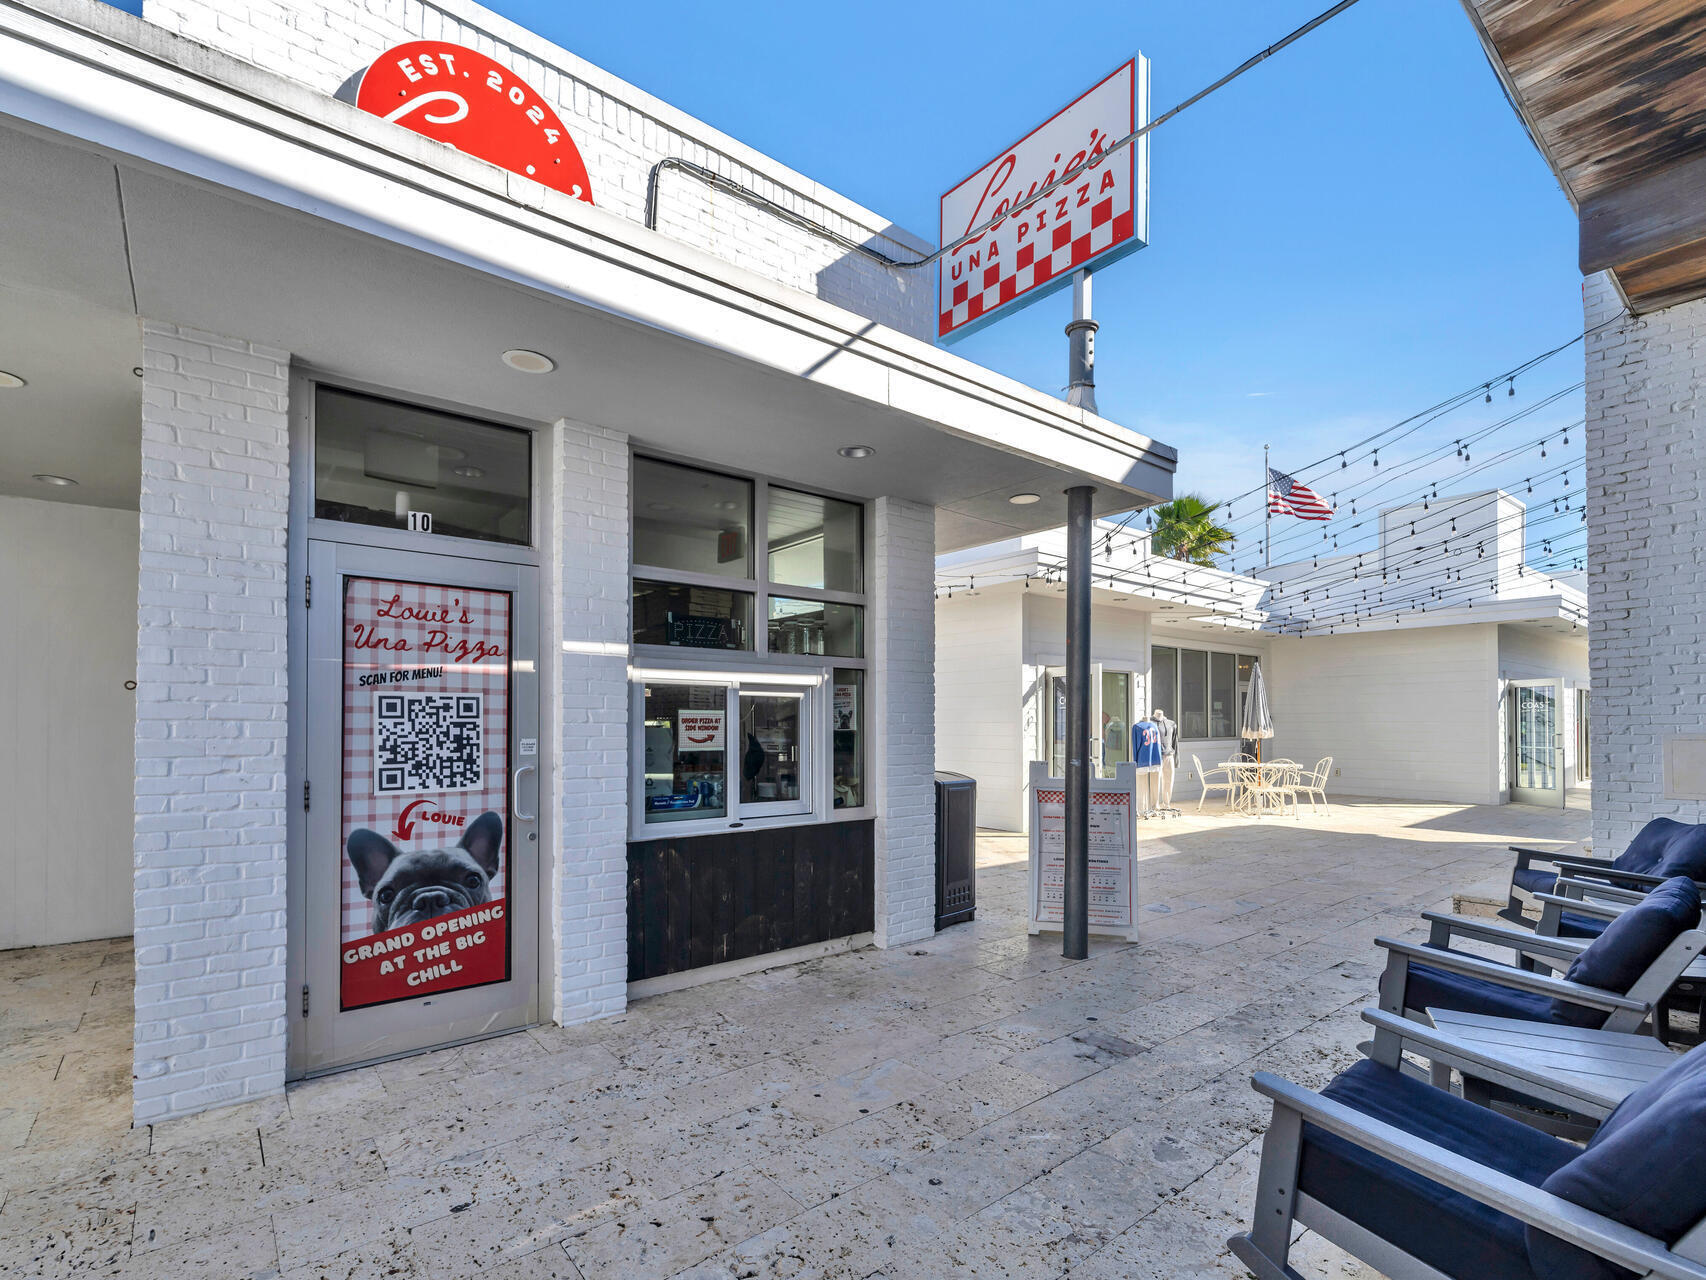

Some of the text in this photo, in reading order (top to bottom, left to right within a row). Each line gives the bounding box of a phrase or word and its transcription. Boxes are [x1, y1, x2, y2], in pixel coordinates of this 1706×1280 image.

[397, 52, 470, 83] EST.
[486, 70, 561, 145] 2024
[951, 128, 1116, 257] Louie's
[951, 169, 1115, 281] UNA PIZZA
[411, 512, 430, 532] 10
[376, 594, 475, 625] Louie's
[353, 623, 504, 664] Una Pizza
[674, 622, 729, 641] PIZZA
[359, 666, 443, 687] SCAN FOR MENU!
[421, 811, 466, 827] LOUIE
[343, 905, 504, 965] GRAND OPENING
[380, 931, 487, 975] AT THE BIG
[407, 960, 463, 986] CHILL
